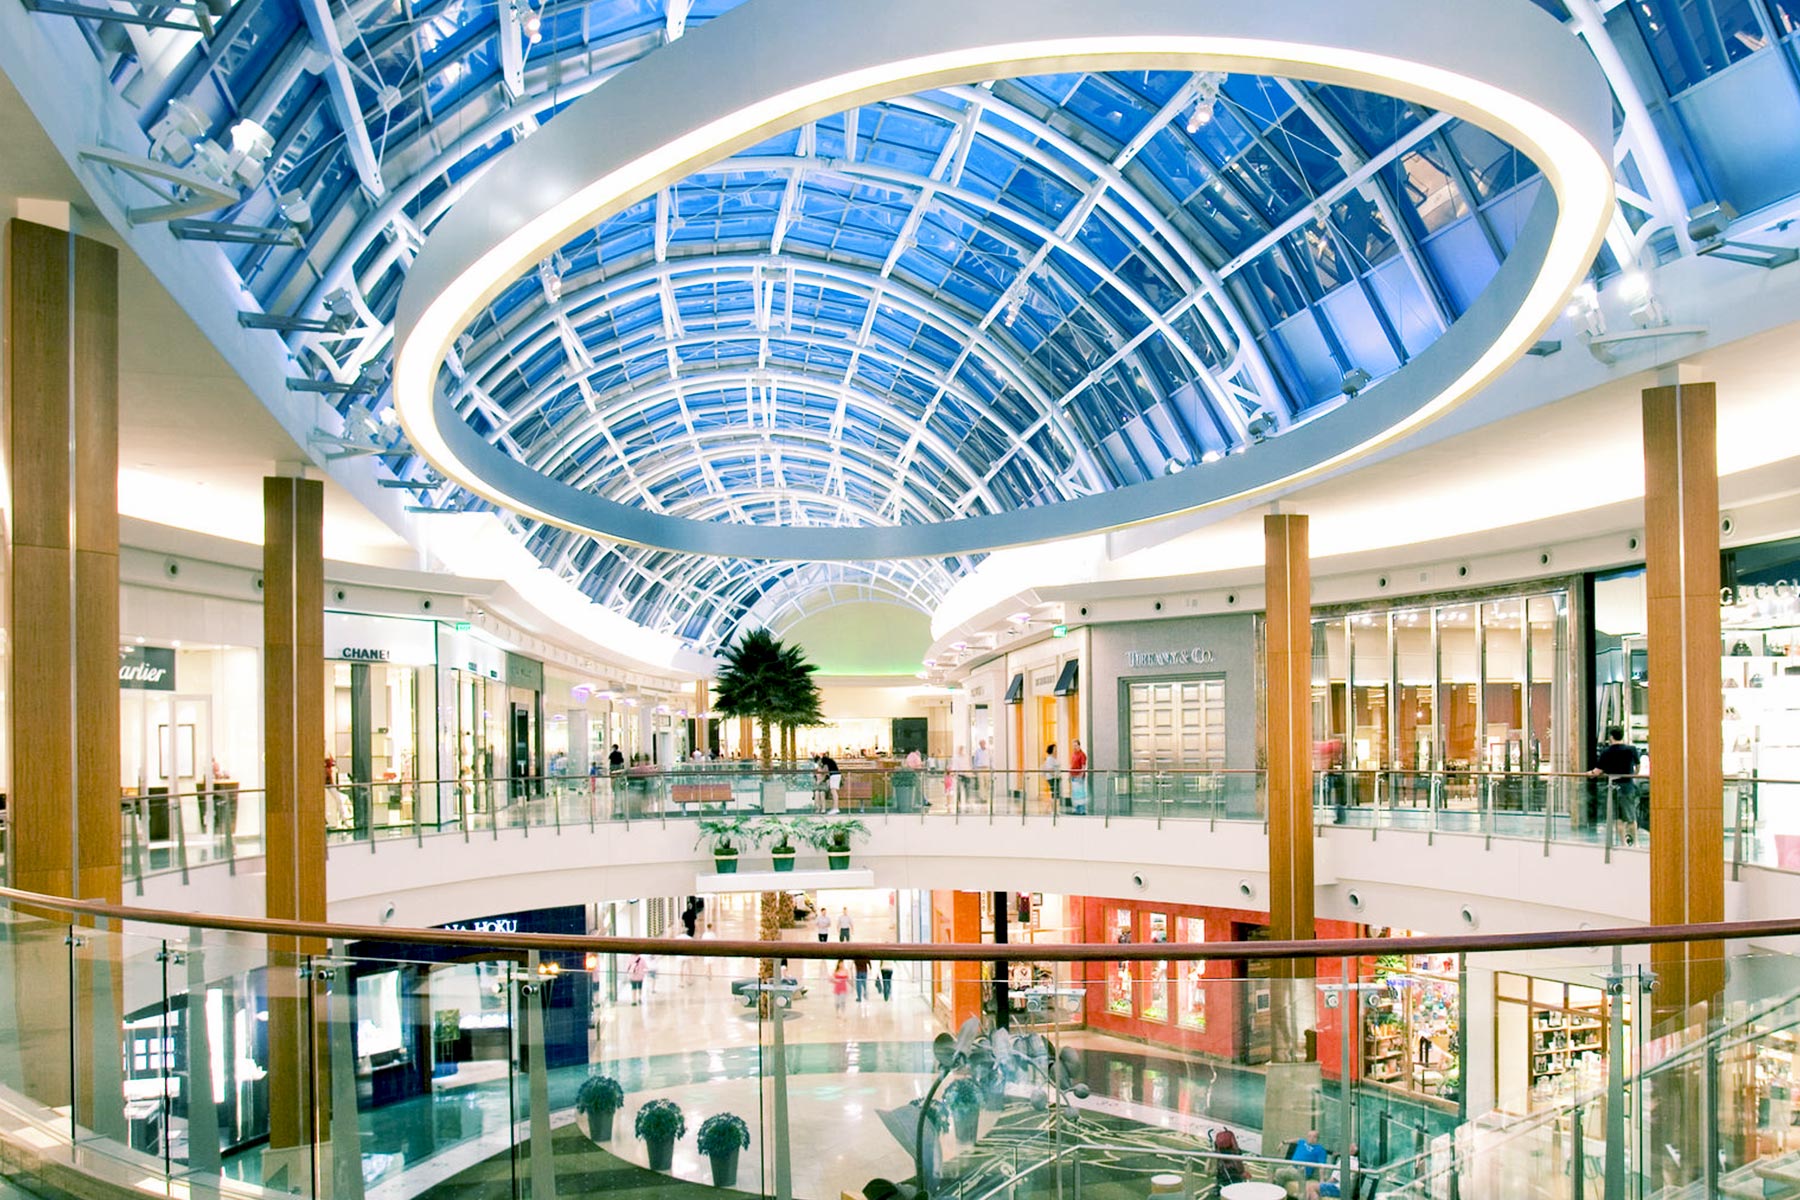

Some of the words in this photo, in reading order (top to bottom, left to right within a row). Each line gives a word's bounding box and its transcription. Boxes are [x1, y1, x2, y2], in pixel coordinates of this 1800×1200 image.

[1720, 578, 1799, 606] GCCI
[119, 661, 166, 682] artier
[474, 919, 517, 933] HOKU
